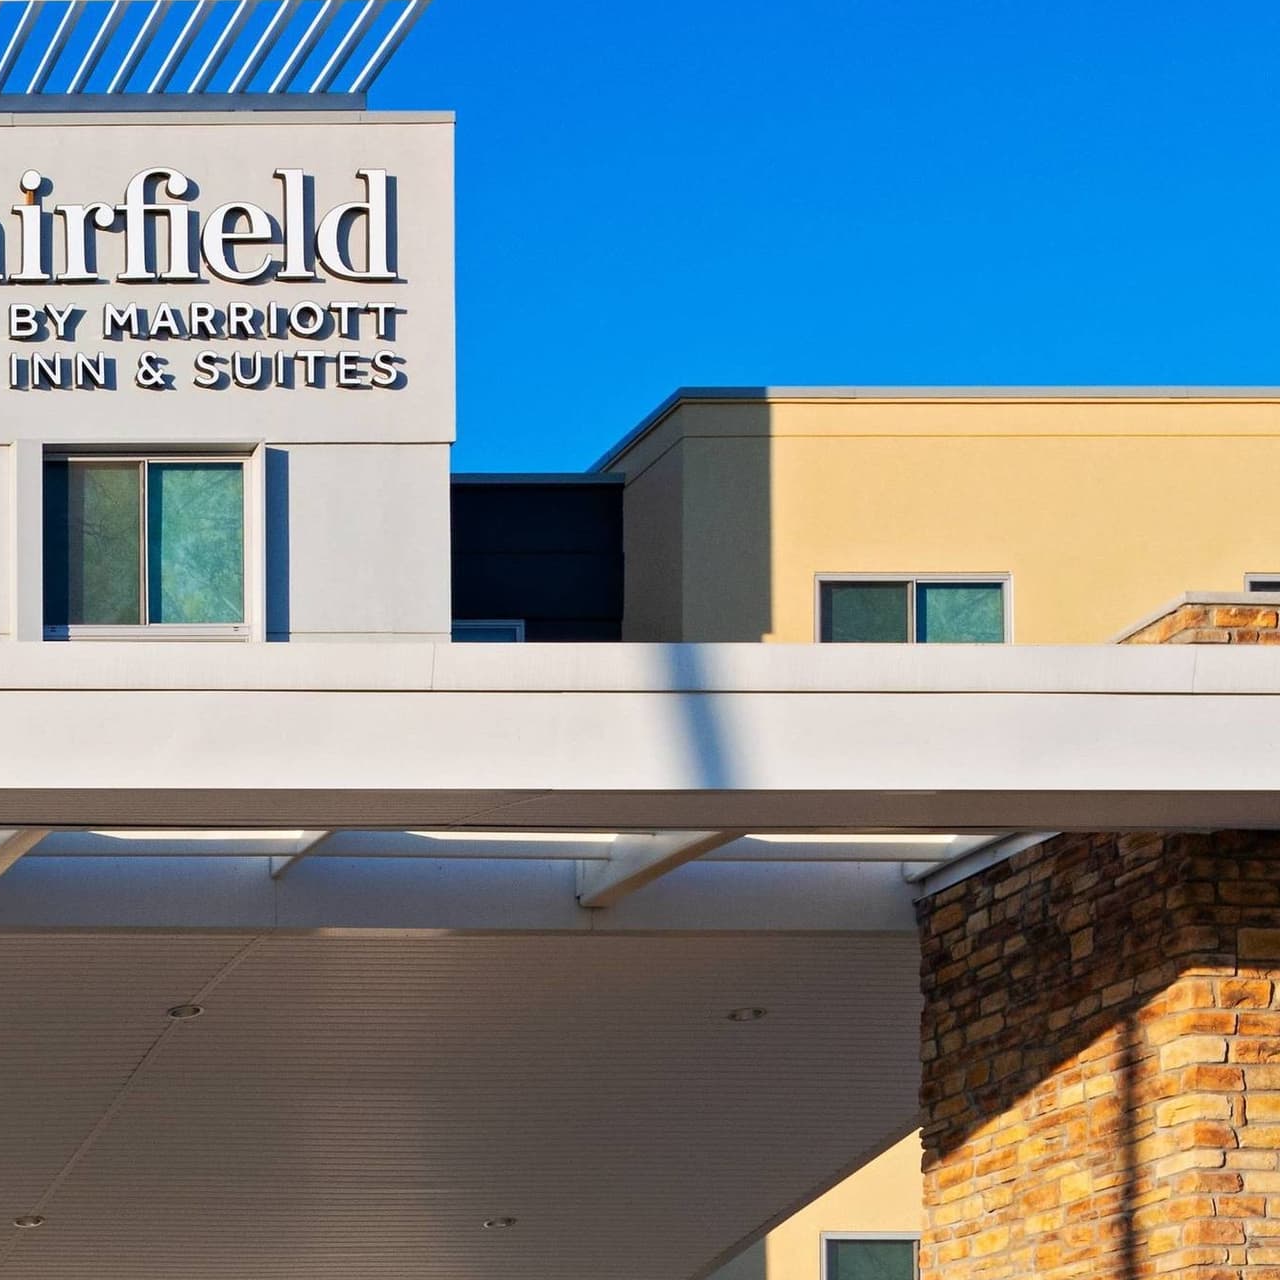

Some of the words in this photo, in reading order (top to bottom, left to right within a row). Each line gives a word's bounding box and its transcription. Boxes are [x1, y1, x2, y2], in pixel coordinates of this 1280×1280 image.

[9, 303, 78, 339] BY
[103, 302, 399, 339] MARRIOTT
[9, 352, 109, 389] INN
[136, 351, 168, 389] &
[194, 350, 400, 389] SUITES
